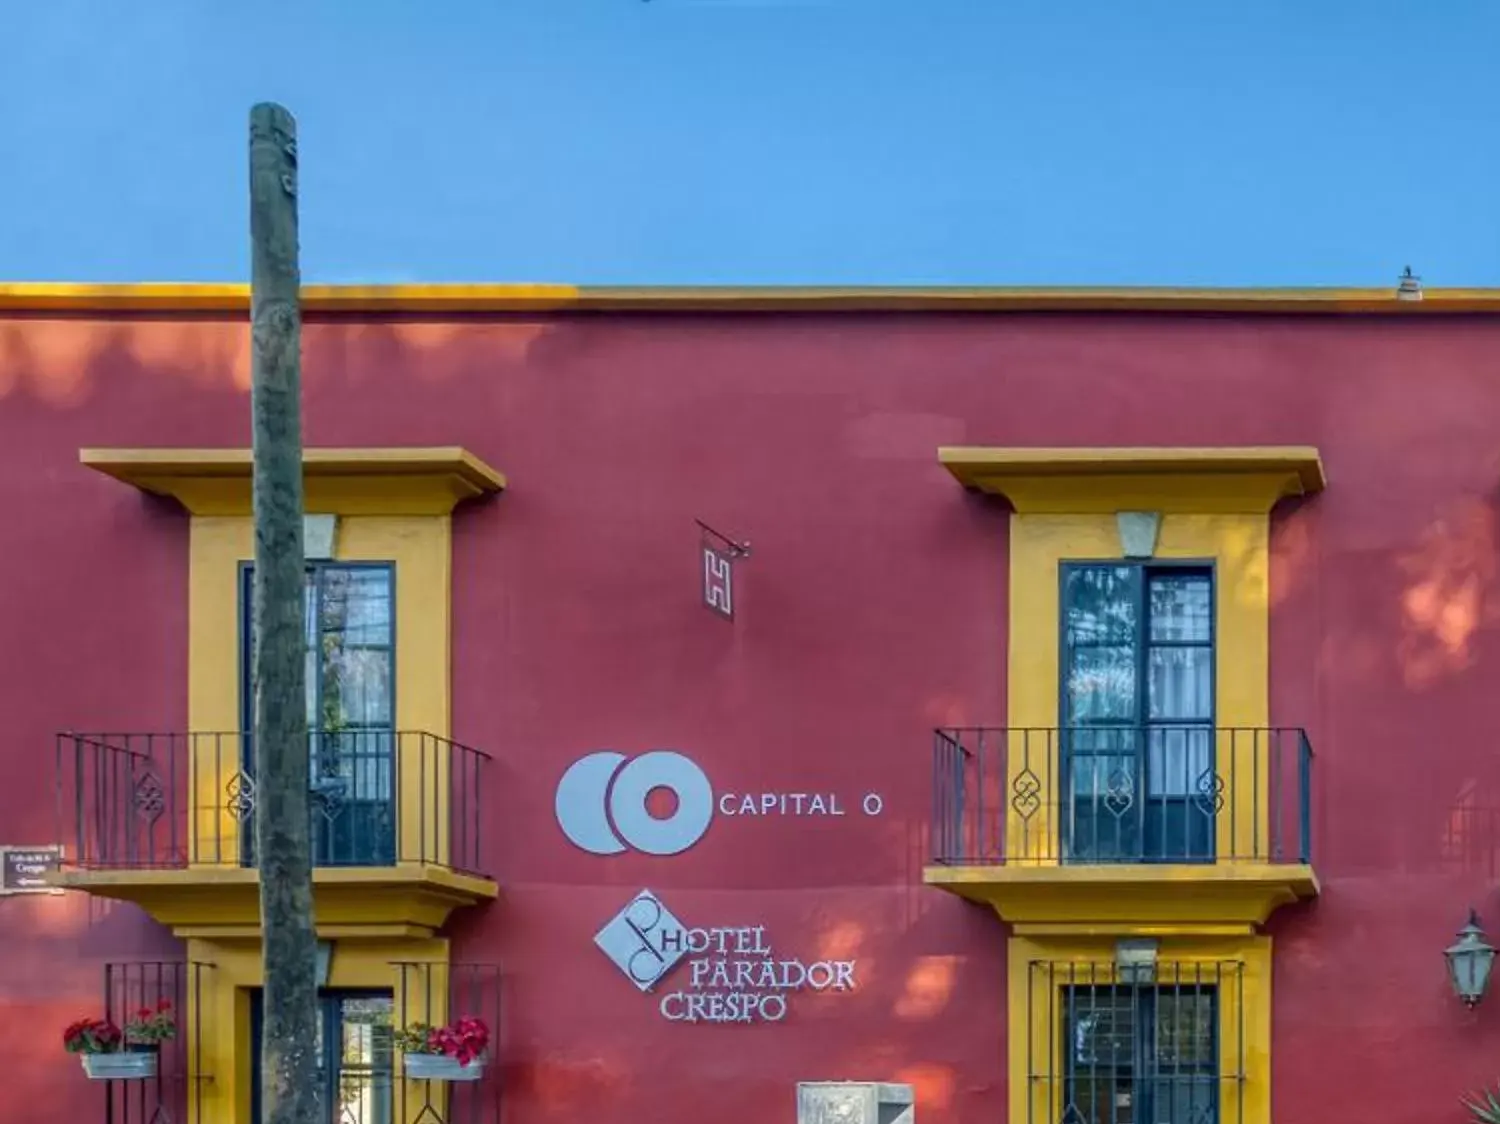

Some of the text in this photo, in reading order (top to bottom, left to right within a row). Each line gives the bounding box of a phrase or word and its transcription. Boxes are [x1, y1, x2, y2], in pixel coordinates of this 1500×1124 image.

[719, 793, 883, 815] CAPITAL O
[661, 926, 771, 955] HOTEL
[690, 958, 856, 990] PARADOR
[660, 990, 787, 1022] CRESPO
